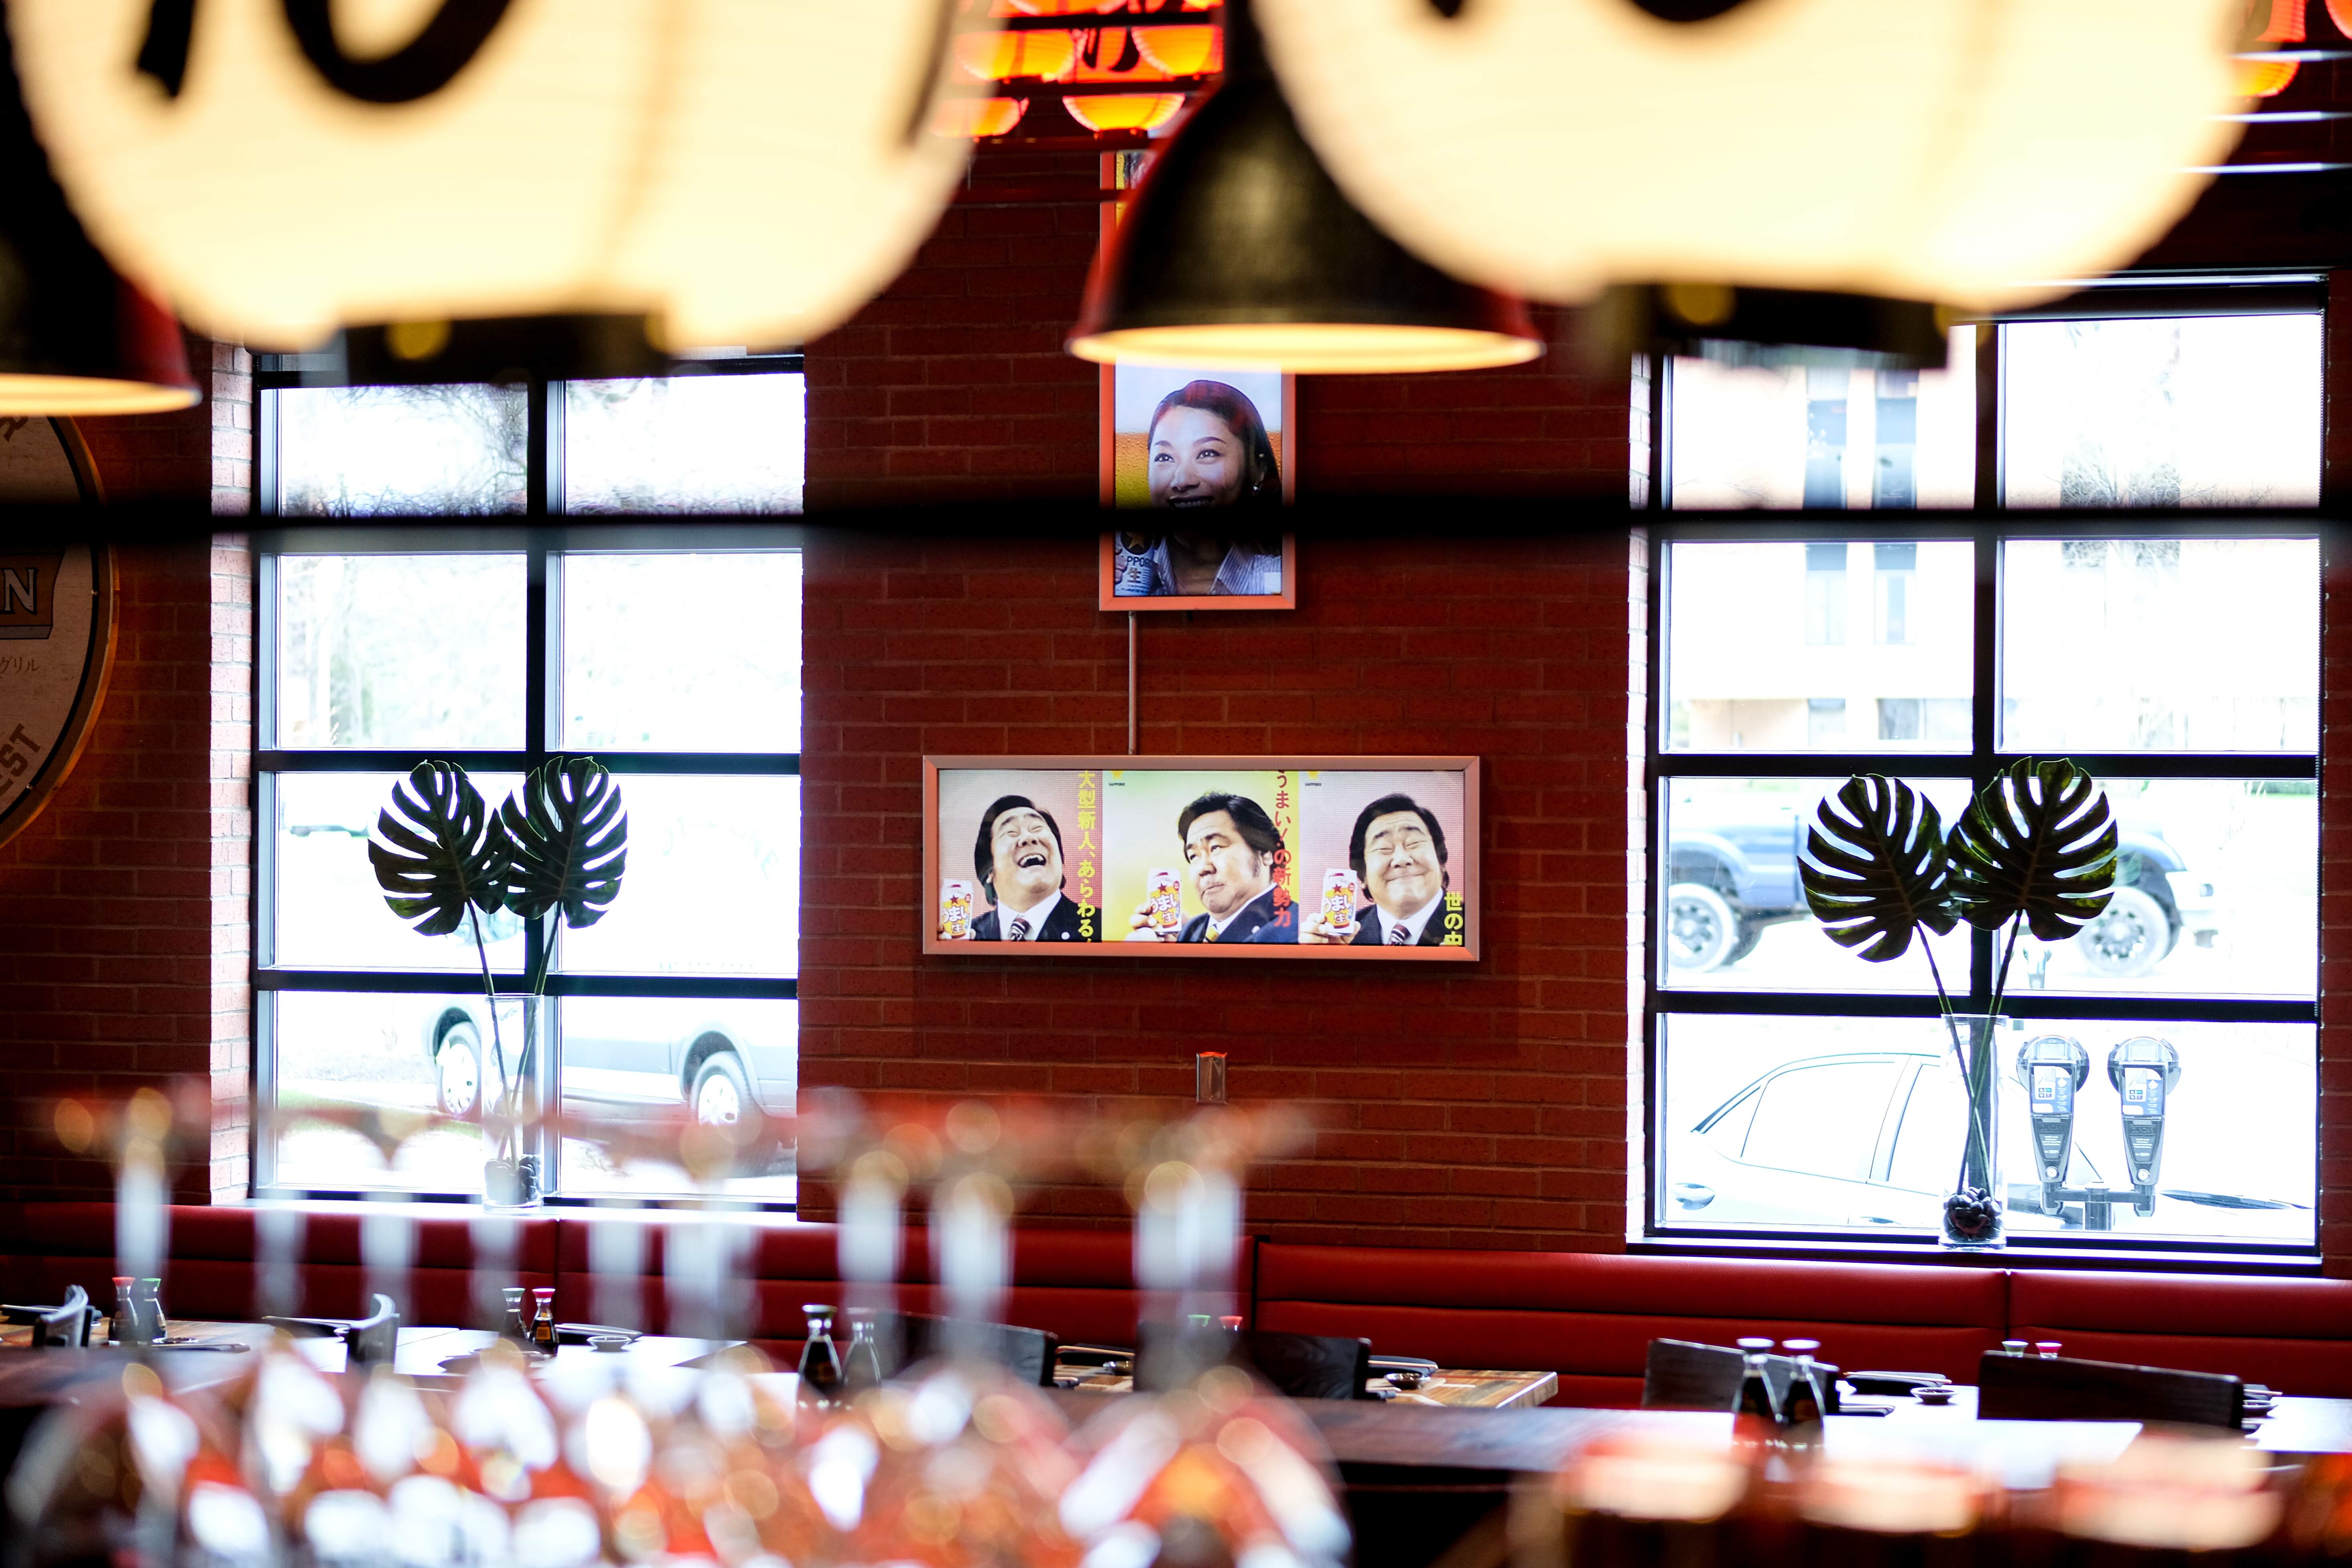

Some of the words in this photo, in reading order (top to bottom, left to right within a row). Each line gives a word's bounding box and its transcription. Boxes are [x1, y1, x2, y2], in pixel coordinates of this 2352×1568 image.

[1077, 771, 1096, 942] 大型新人、あらわる
